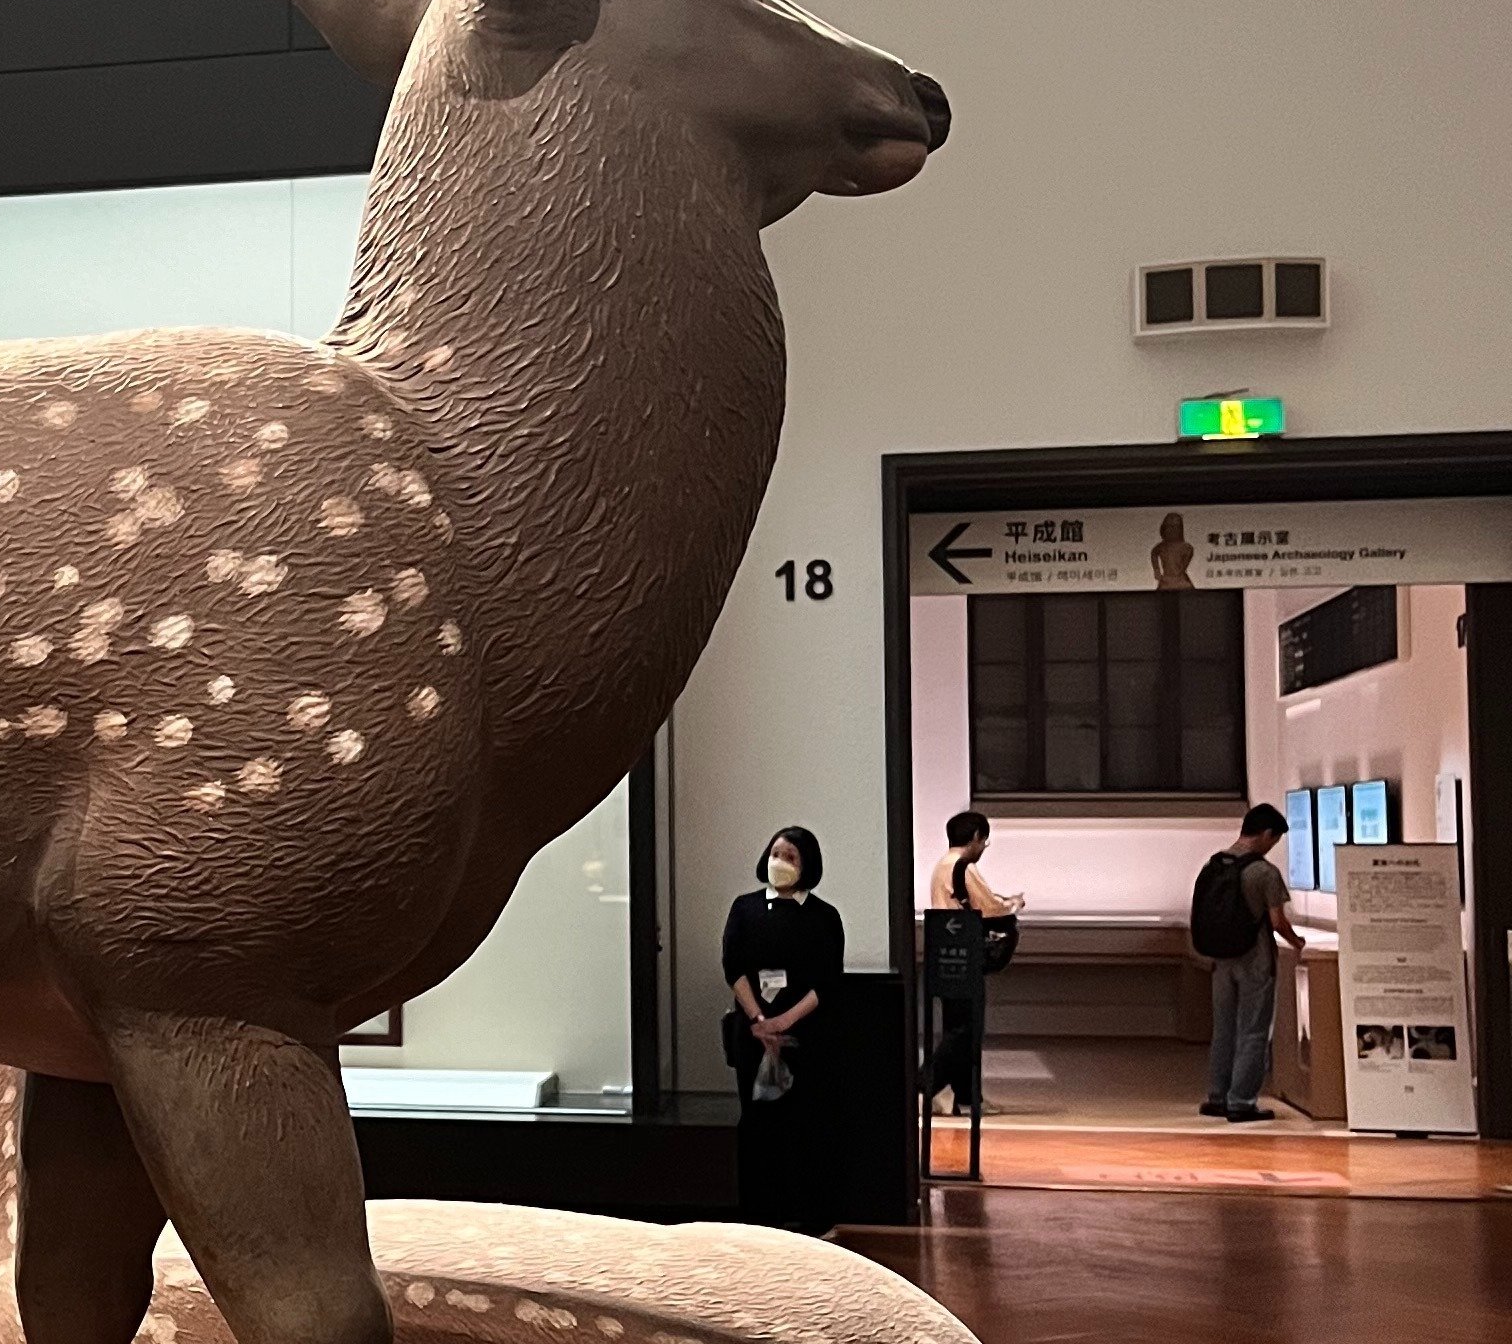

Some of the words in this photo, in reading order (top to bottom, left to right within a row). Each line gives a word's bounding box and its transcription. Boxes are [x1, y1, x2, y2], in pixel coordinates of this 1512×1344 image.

[1005, 520, 1084, 545] 平成館
[1004, 549, 1089, 564] Heiseikan
[1206, 551, 1269, 563] Japanese
[1358, 546, 1406, 560] Gallery
[775, 559, 834, 602] 18
